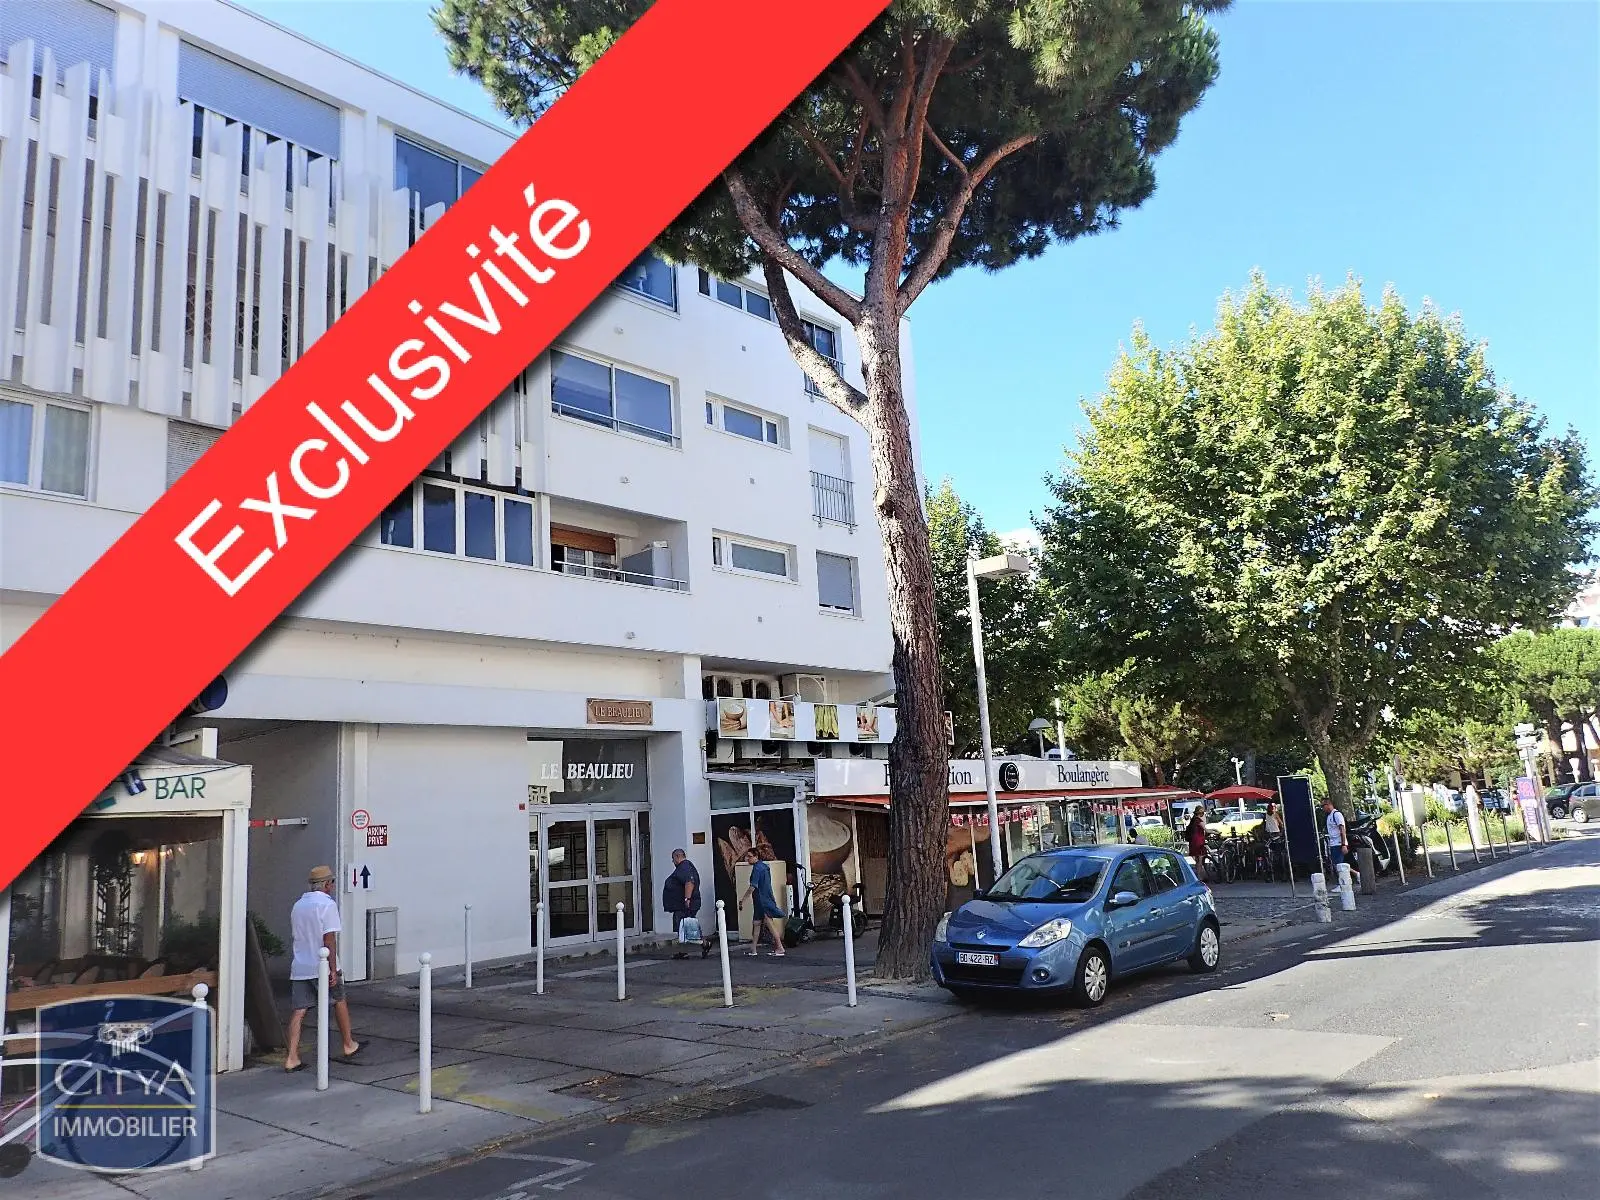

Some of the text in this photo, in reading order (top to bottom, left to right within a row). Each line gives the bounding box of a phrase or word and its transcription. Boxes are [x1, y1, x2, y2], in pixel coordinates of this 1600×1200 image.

[595, 706, 646, 718] LE BEAULIEU
[541, 763, 634, 780] LE BEAULIEU
[1056, 764, 1109, 786] Boulangère
[155, 777, 207, 800] BAR
